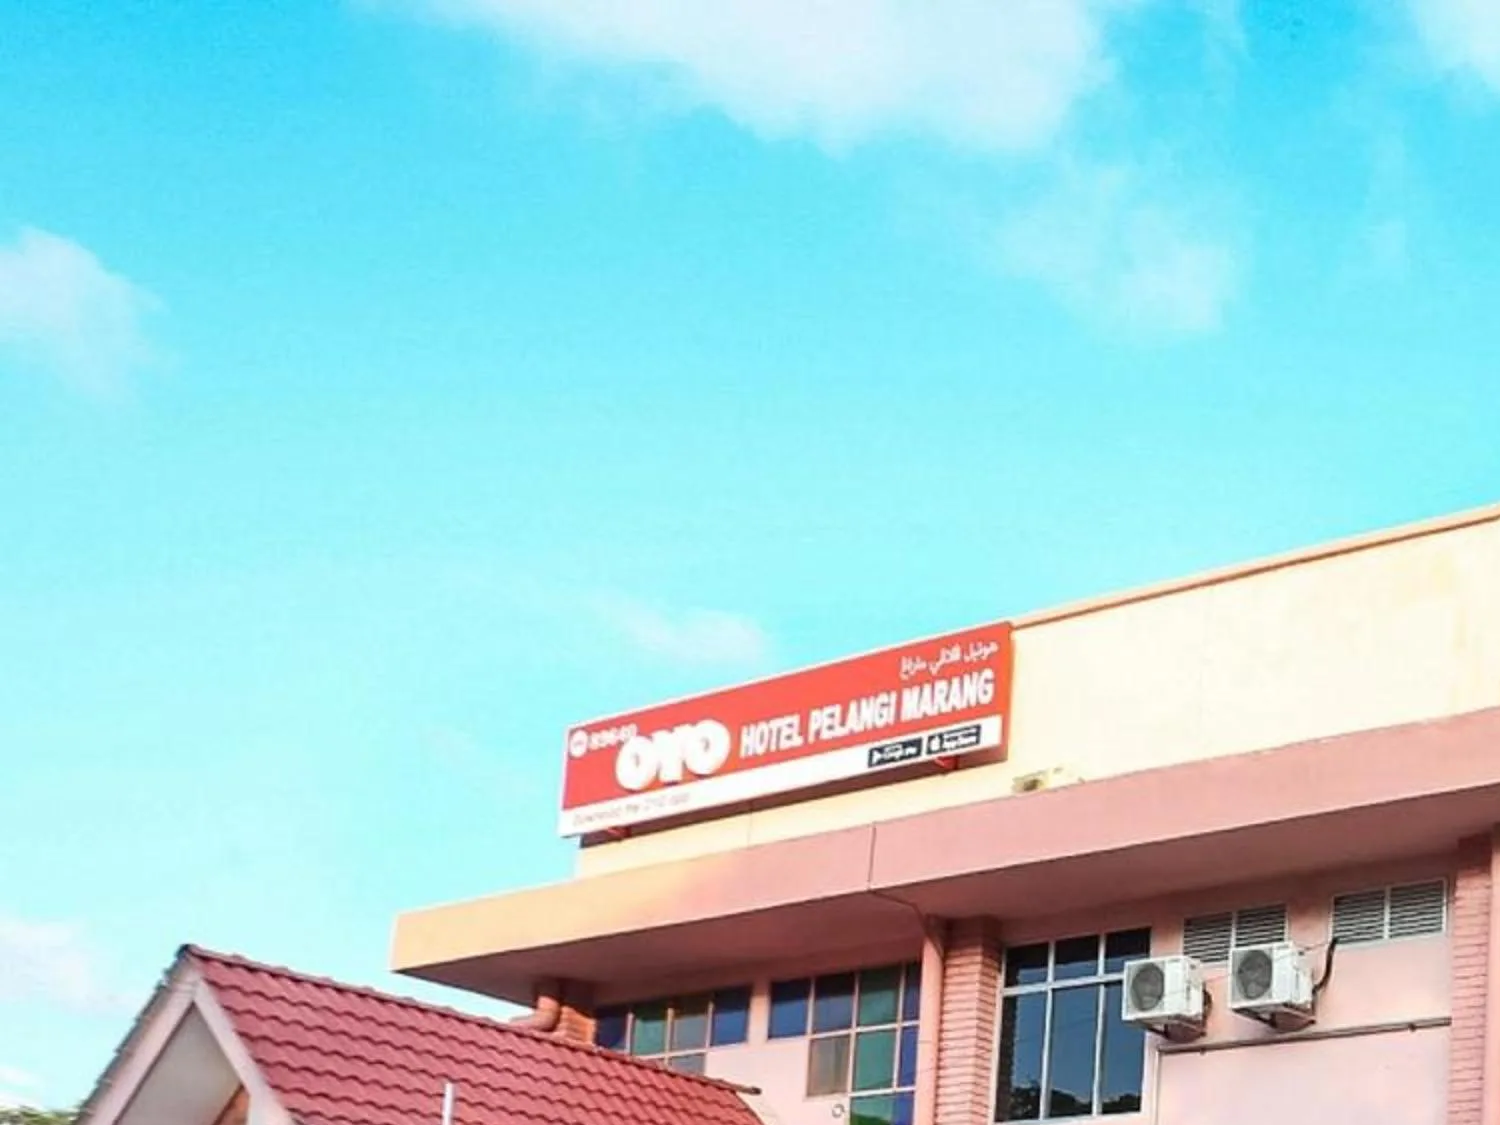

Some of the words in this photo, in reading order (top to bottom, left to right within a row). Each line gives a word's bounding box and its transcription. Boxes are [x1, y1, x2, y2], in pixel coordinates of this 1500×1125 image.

[739, 714, 803, 757] HOTEL
[808, 690, 897, 742] PELANGI
[900, 668, 995, 721] MARANG
[615, 719, 731, 791] OYO
